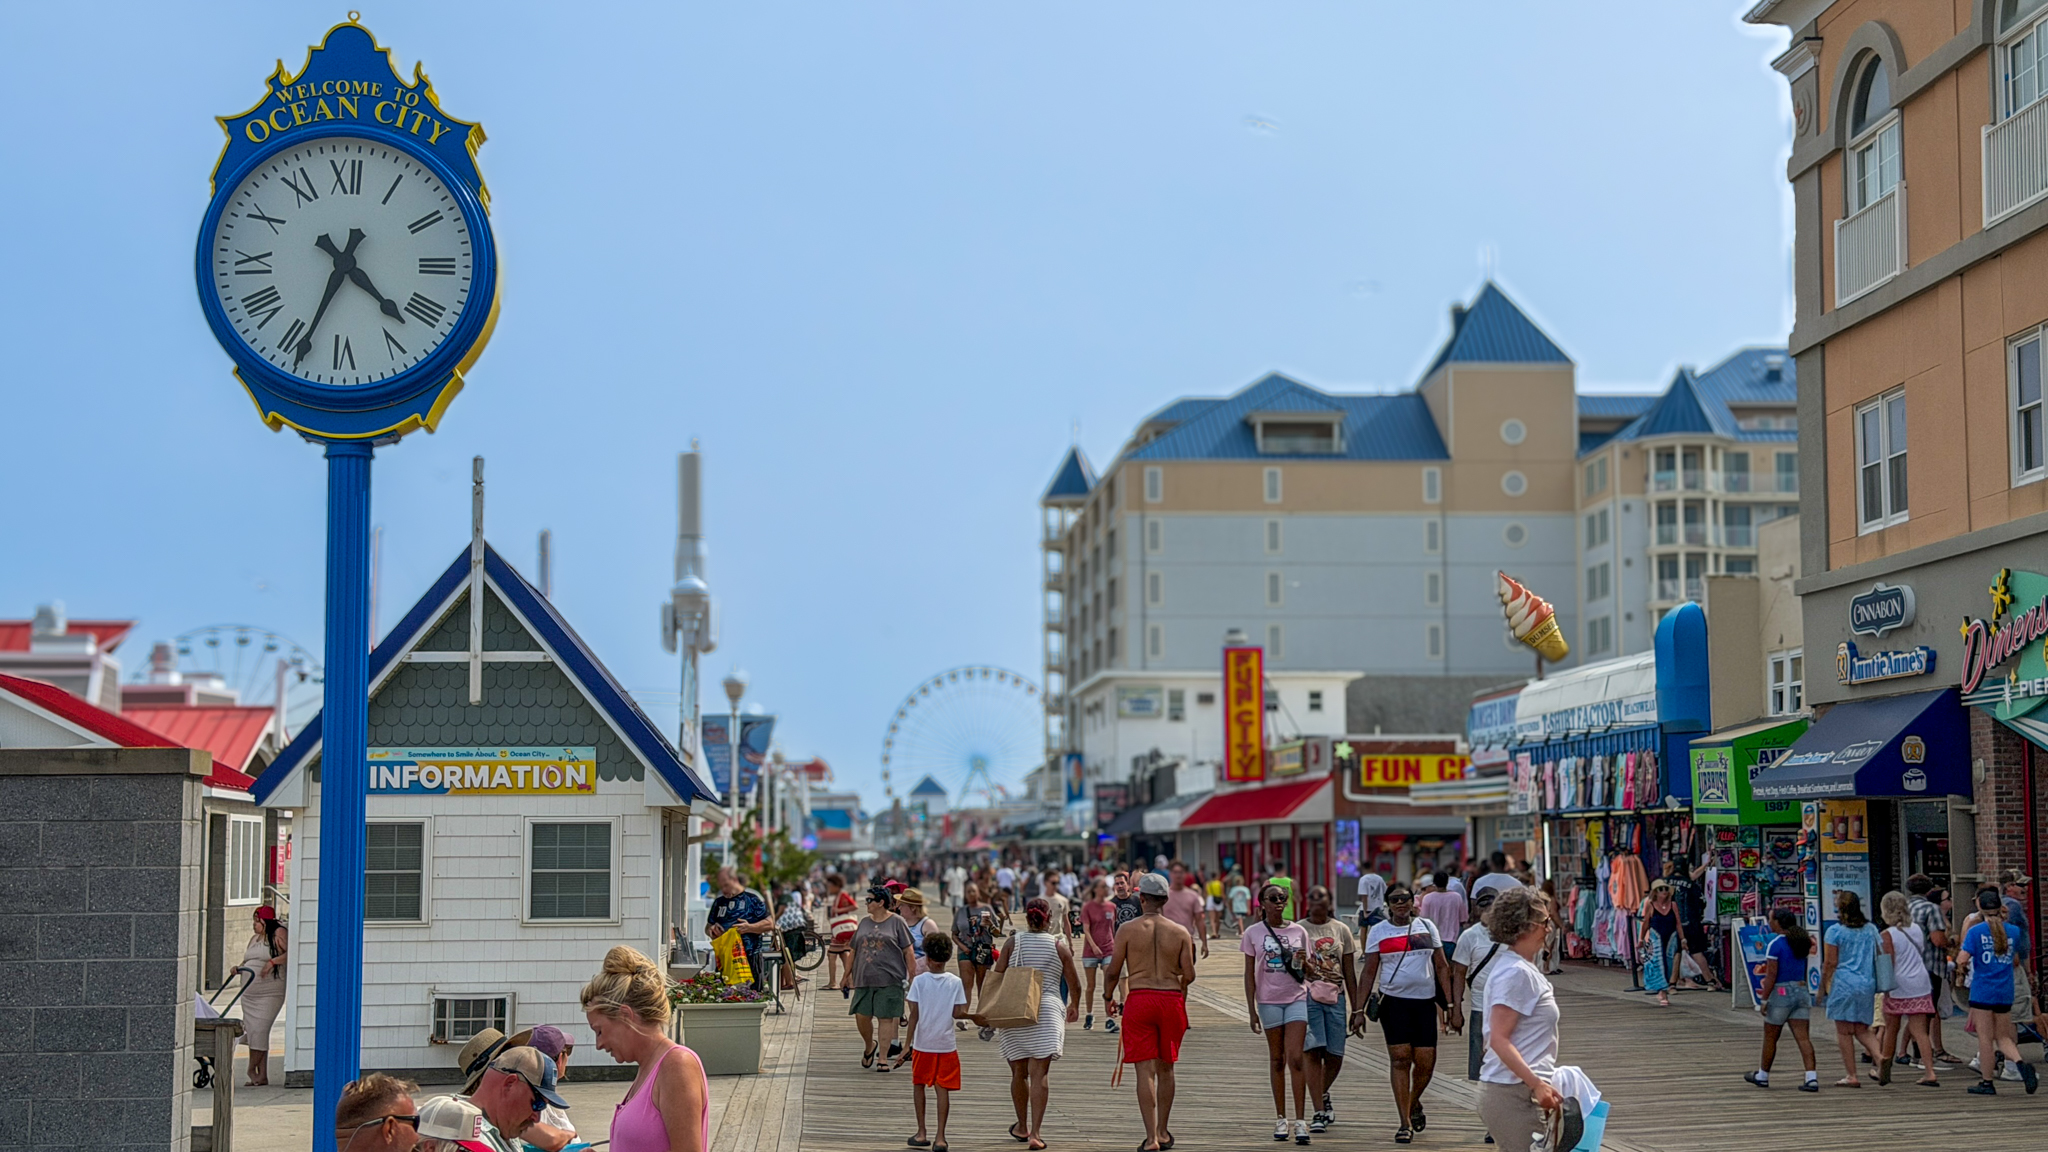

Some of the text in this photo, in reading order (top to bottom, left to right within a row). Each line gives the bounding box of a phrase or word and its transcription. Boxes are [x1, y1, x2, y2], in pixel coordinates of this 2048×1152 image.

[275, 79, 420, 107] WELCOME TO
[245, 96, 452, 146] OCEAN CITY
[280, 166, 319, 209] XI
[329, 158, 363, 195] XII
[246, 202, 287, 235] X
[234, 249, 273, 275] IX
[418, 257, 456, 276] III
[241, 285, 285, 330] VIII
[333, 334, 356, 370] VI
[1853, 597, 1902, 625] CINNABON
[1236, 652, 1256, 776] FUN CITY
[1541, 708, 1576, 735] T-SHIRT
[1576, 700, 1623, 730] FACTORY
[369, 764, 587, 790] INFORMATION
[1365, 758, 1422, 782] FUN
[1764, 802, 1791, 812] 1987
[1849, 864, 1868, 873] Dogs
